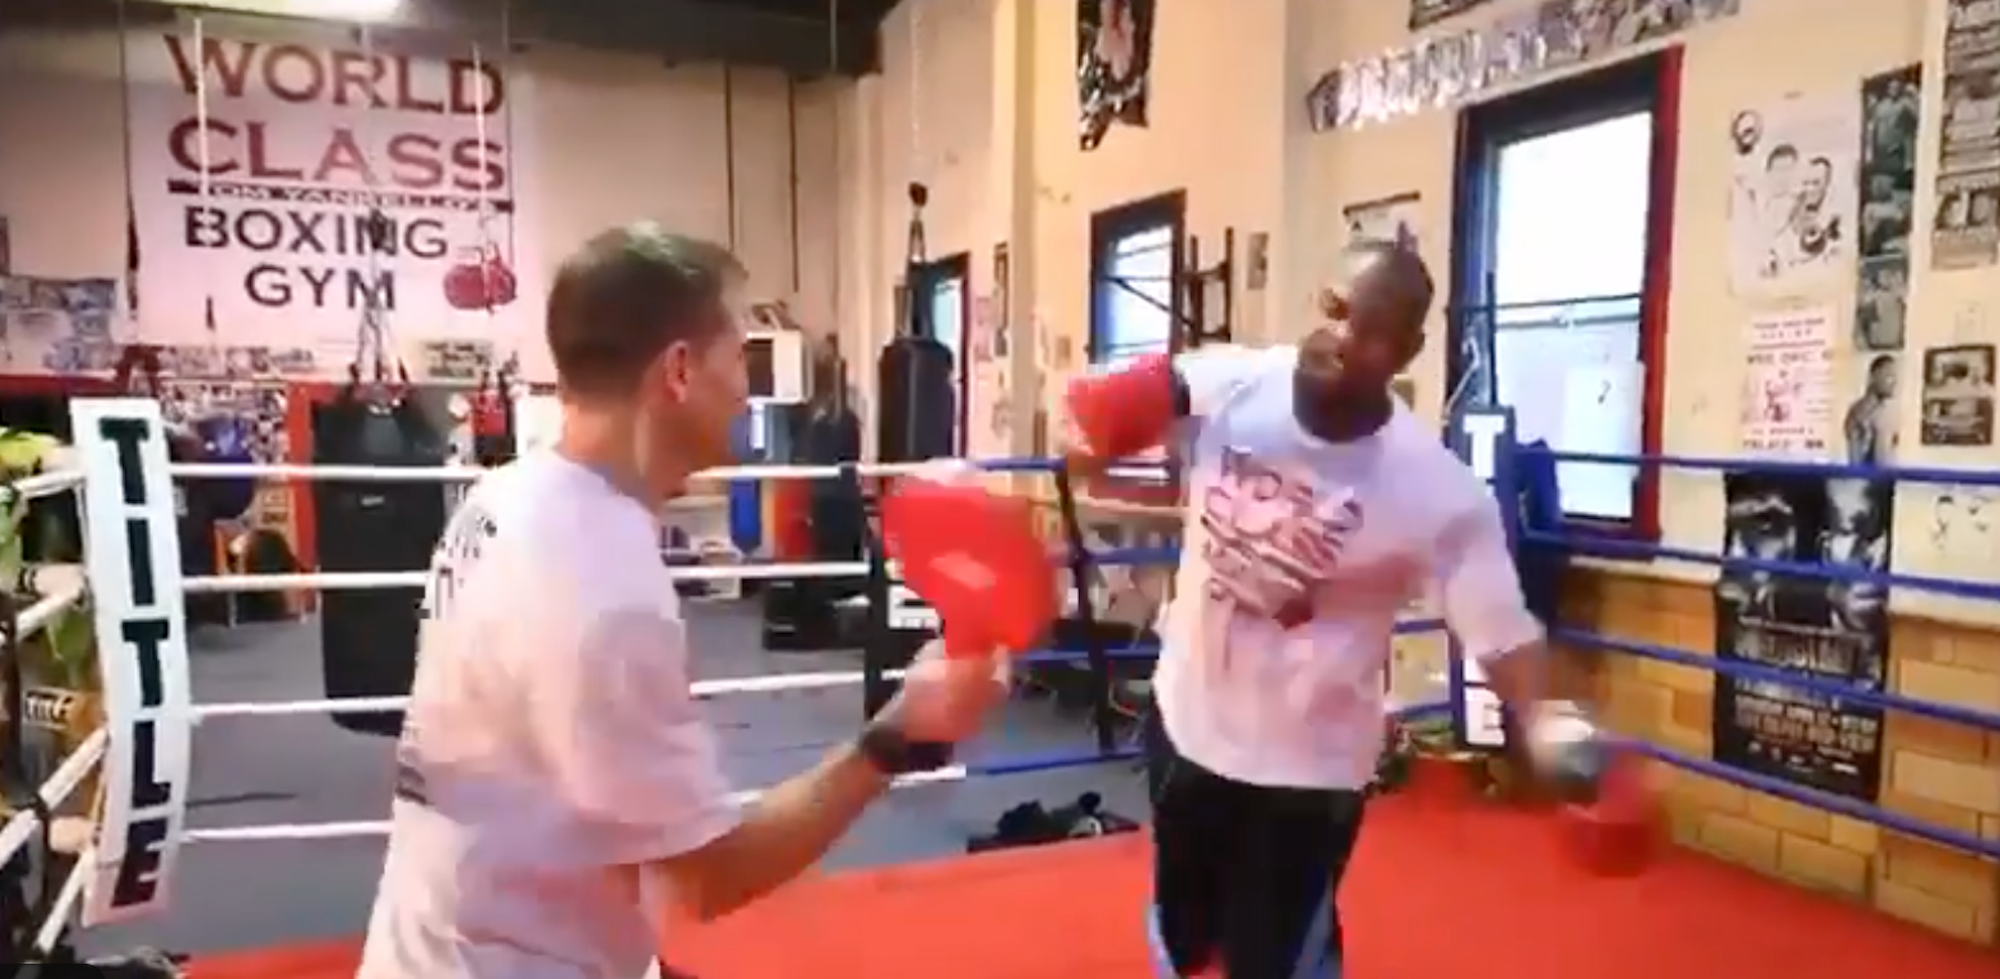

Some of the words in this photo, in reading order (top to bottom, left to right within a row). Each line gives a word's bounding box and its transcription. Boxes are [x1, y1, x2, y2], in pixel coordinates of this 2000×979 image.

[164, 34, 502, 115] WORLD
[167, 117, 505, 192] CLASS
[183, 203, 449, 259] BOXING
[243, 262, 396, 311] GYM
[99, 416, 172, 908] TITLE
